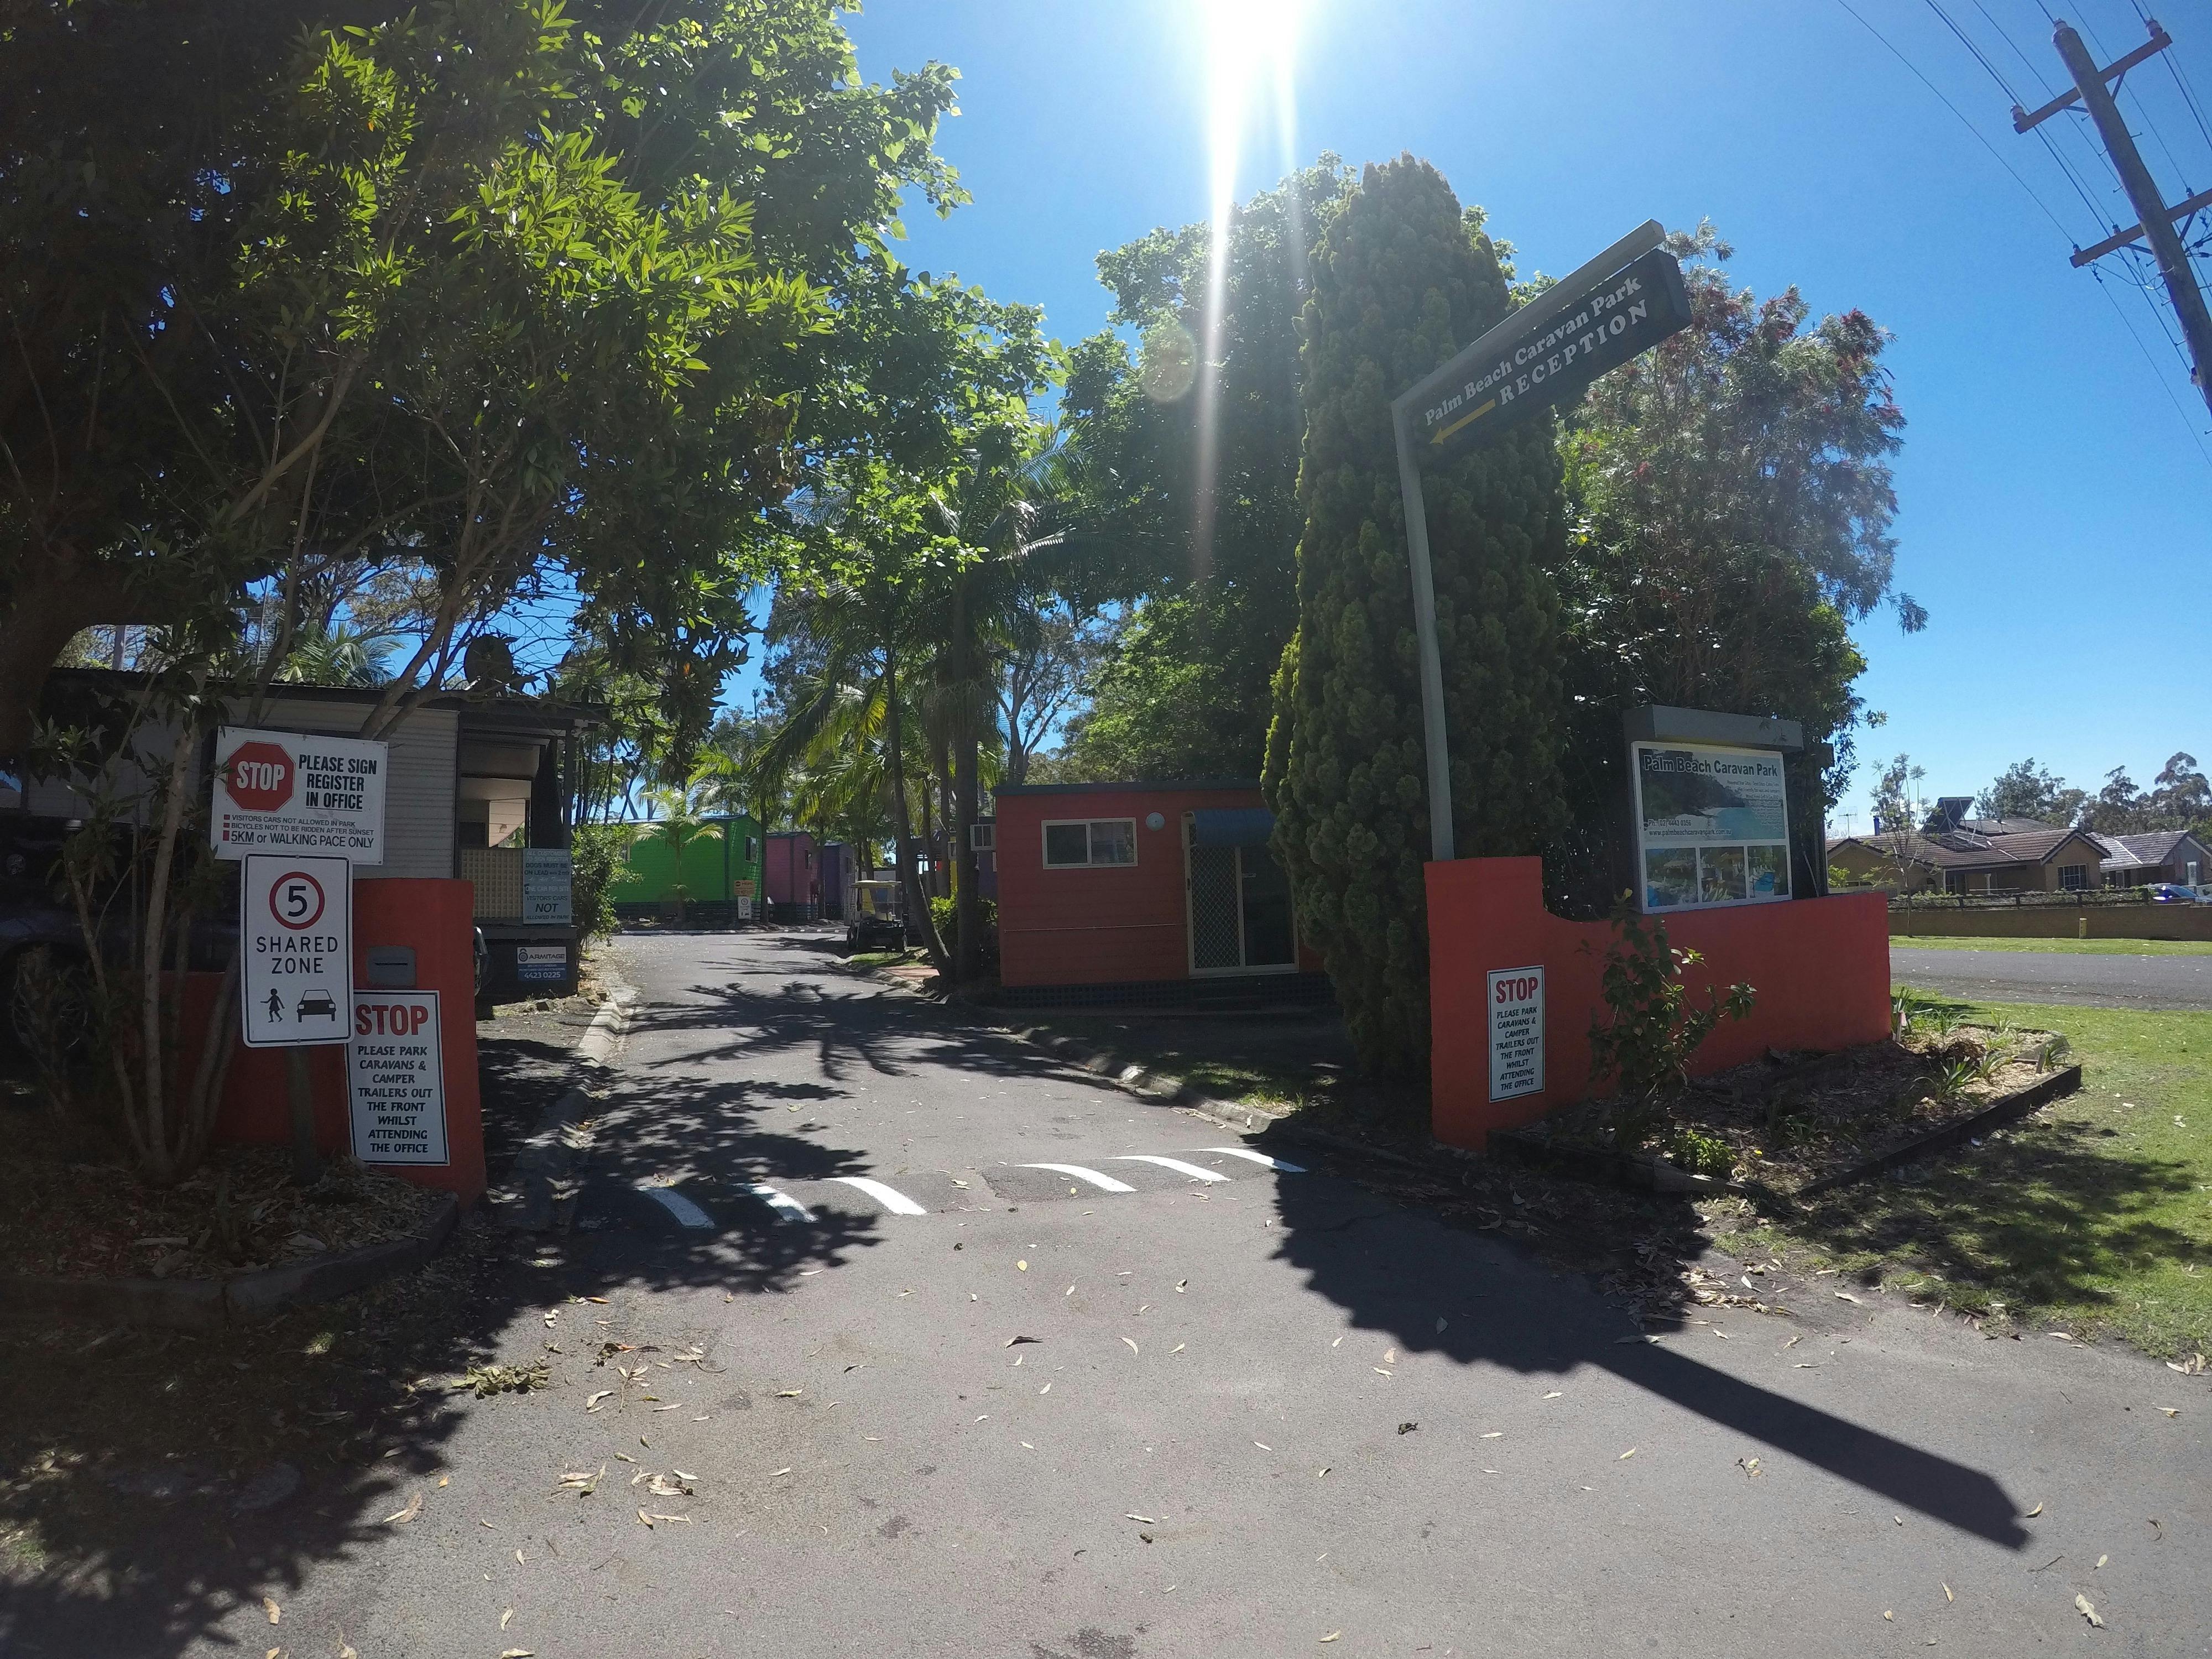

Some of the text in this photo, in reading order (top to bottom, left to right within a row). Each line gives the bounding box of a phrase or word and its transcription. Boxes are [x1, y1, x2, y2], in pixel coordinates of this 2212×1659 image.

[1425, 275, 1642, 426] Palm Beach Caravan Park
[1499, 298, 1648, 406] RECEPTION
[299, 754, 377, 775] PLEASE SIGN
[1644, 755, 1777, 776] Palm Beach Caravan Park
[237, 760, 285, 791] STOP
[306, 773, 364, 791] REGISTER
[306, 791, 363, 810] IN OFFICE
[232, 814, 262, 822] VISITORS
[231, 831, 374, 848] 5KM or WALKING PACE ONLY
[288, 885, 307, 917] 5
[535, 903, 559, 912] NOT
[256, 936, 338, 953] SHARED
[271, 957, 324, 974] ZONE
[1496, 977, 1538, 1004] STOP
[1496, 1006, 1538, 1019] PLEASE PARK
[356, 1004, 429, 1036] STOP
[1498, 1019, 1530, 1029] CARAVANS
[1505, 1028, 1530, 1039] CAMPER
[1495, 1036, 1540, 1051] TRAILERS OUT
[358, 1046, 428, 1056] PLEASE PARK
[1500, 1047, 1535, 1060] THE FRONT
[359, 1060, 426, 1071] CARAVANS &
[1506, 1058, 1529, 1070] WHILST
[372, 1074, 415, 1084] CAMPER
[1499, 1067, 1535, 1081] ATTENDING
[1500, 1078, 1534, 1091] THE OFFICE
[358, 1087, 433, 1098] TRAILERS OUT
[367, 1102, 426, 1112] THE FRONT
[377, 1116, 417, 1126] WHILST
[368, 1129, 428, 1140] ATTENDING
[370, 1142, 429, 1154] THE OFFICE
